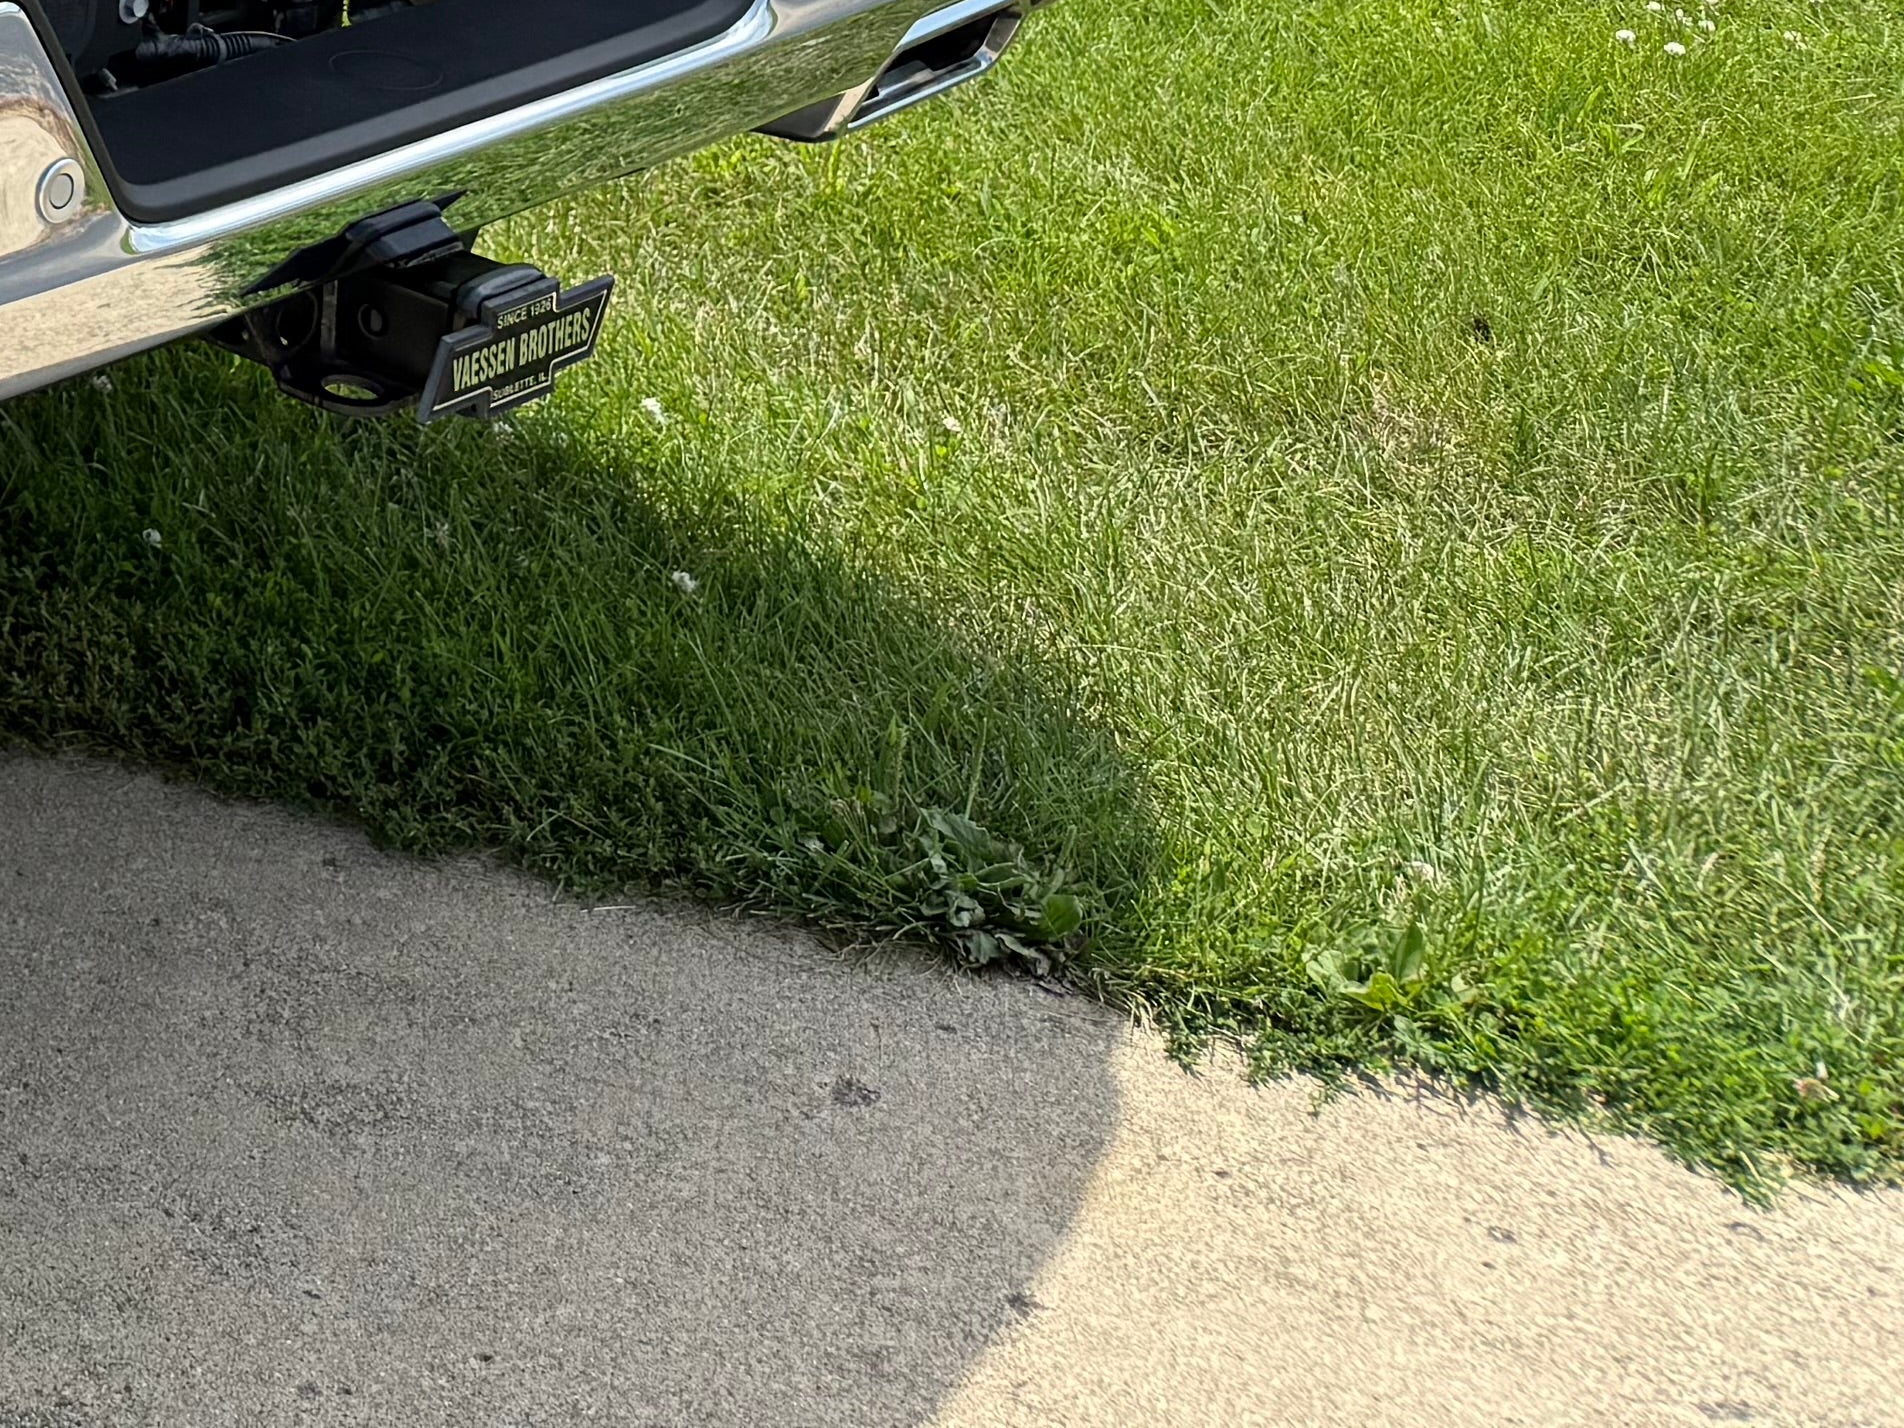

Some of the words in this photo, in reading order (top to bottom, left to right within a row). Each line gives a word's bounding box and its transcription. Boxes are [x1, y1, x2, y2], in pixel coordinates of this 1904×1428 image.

[497, 306, 527, 329] SINCE
[453, 337, 515, 392] VAESSEN
[519, 307, 591, 366] BROTHERS
